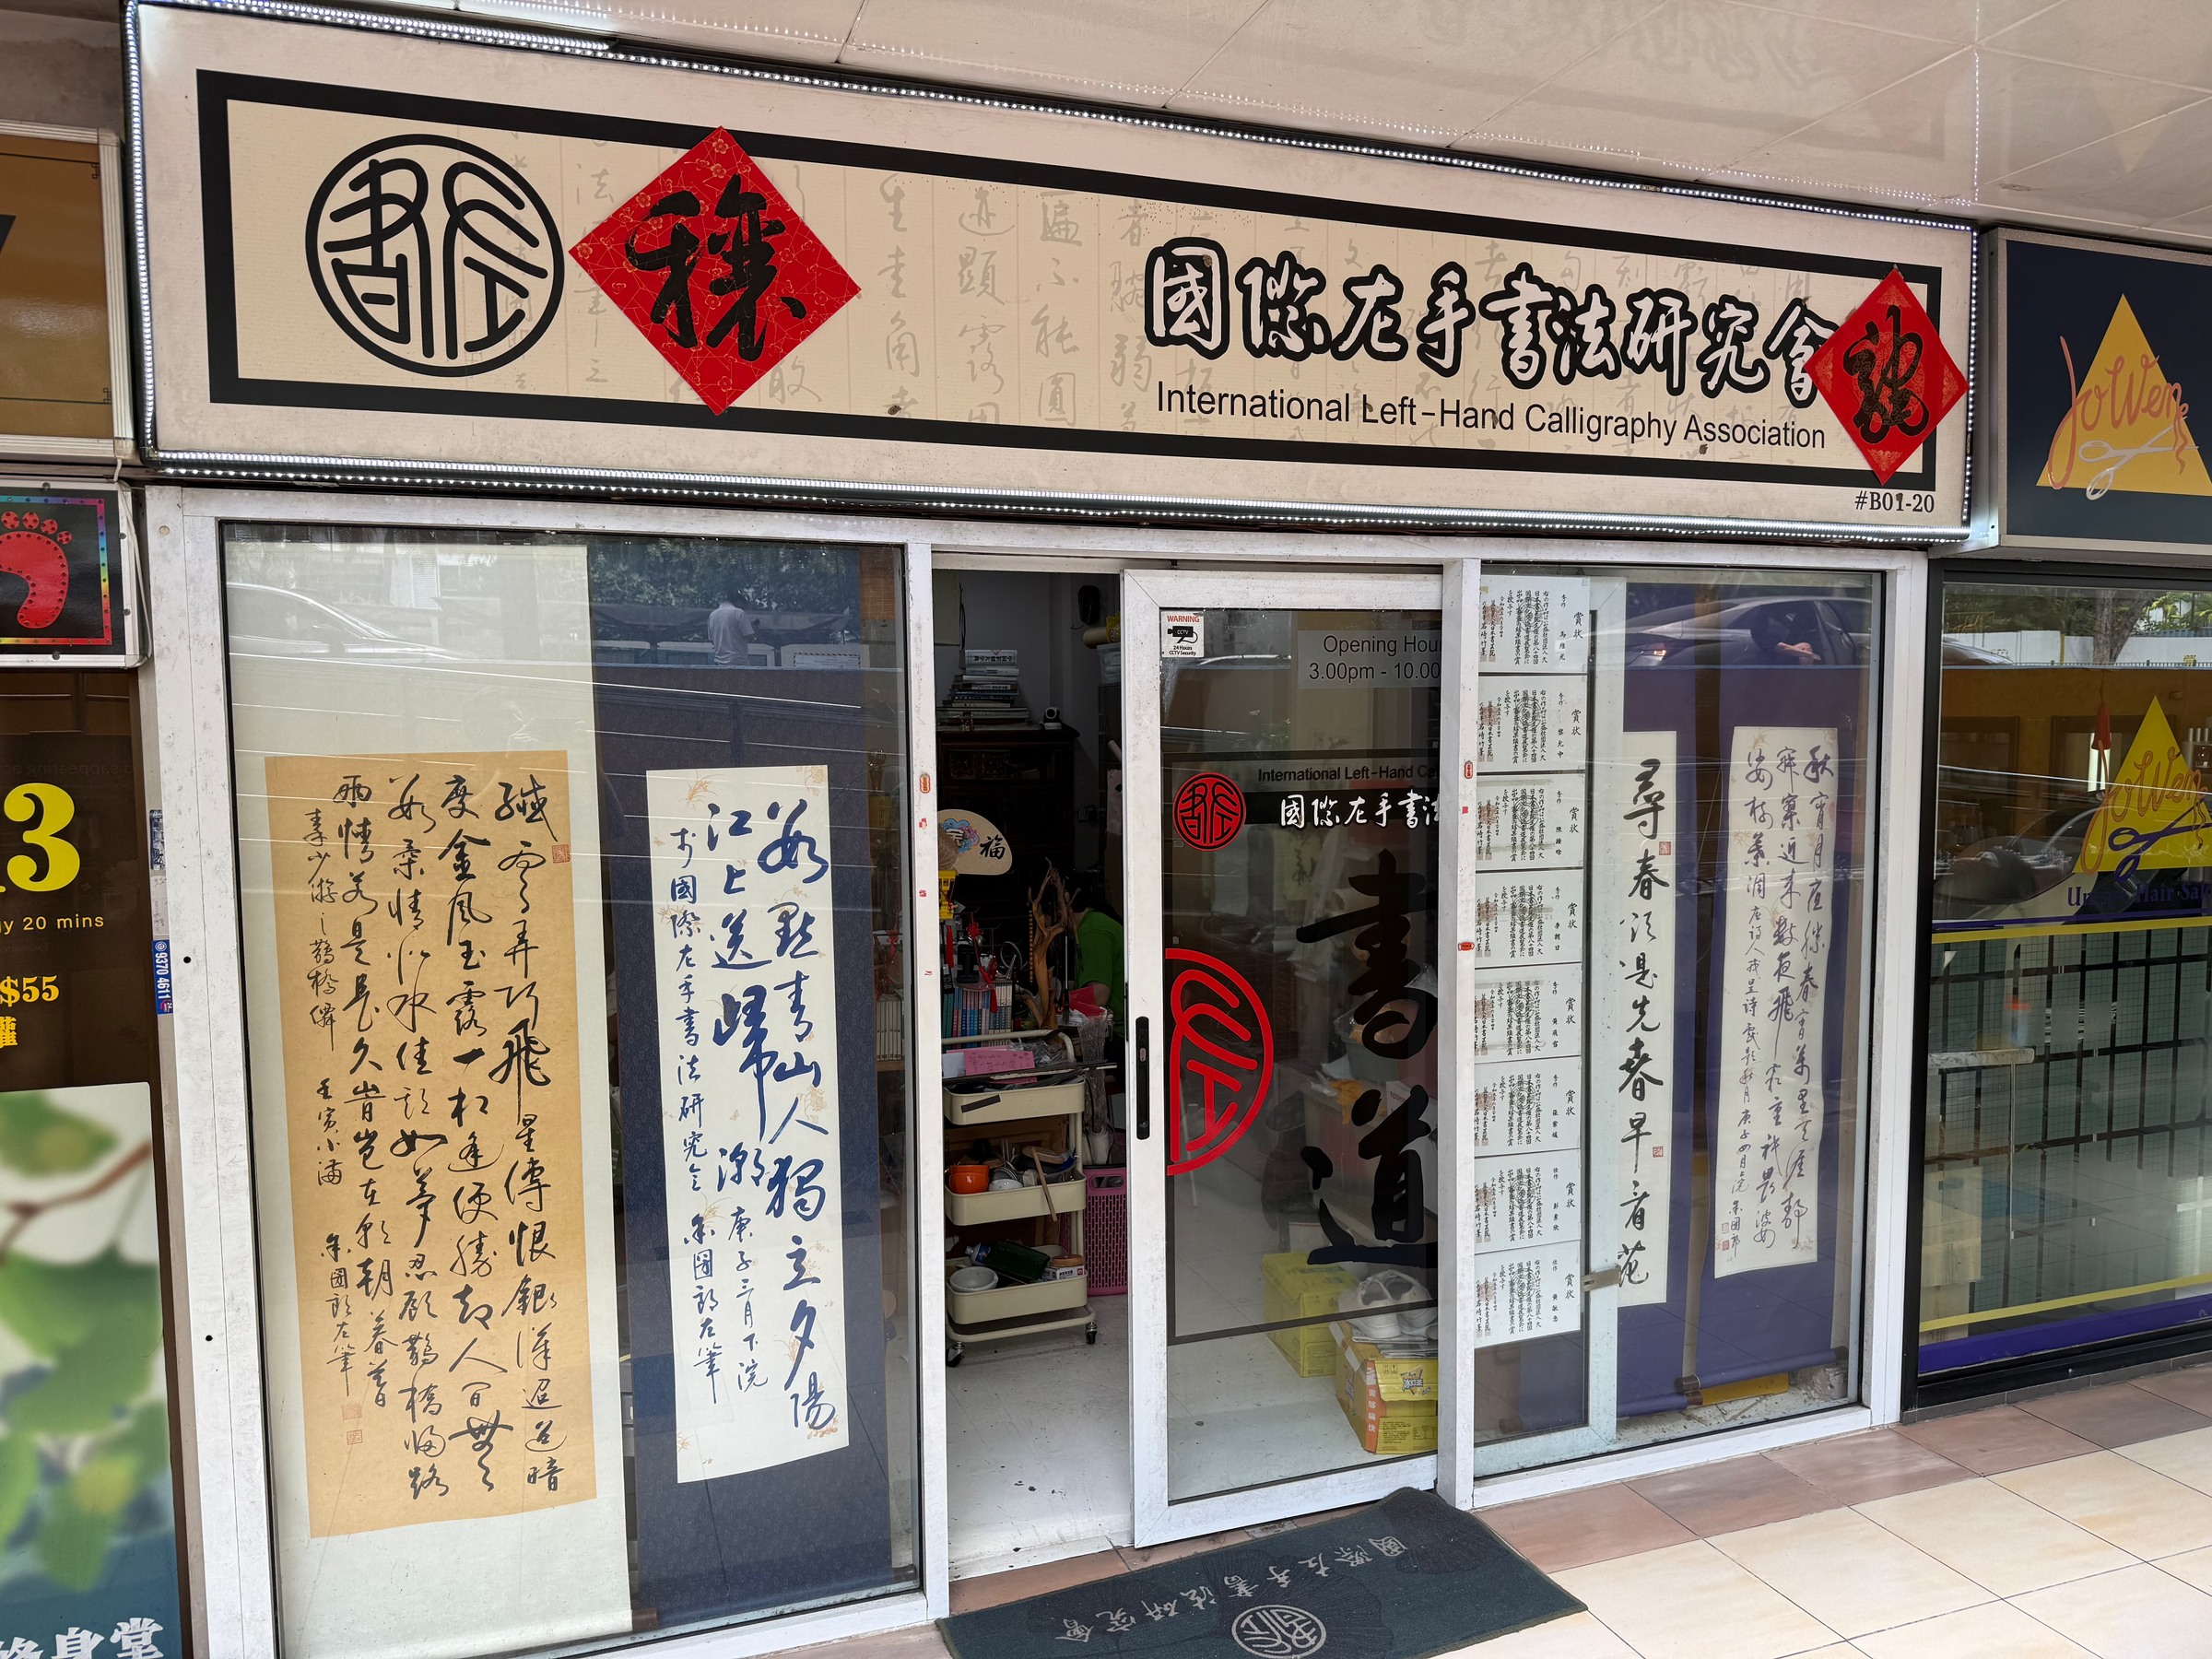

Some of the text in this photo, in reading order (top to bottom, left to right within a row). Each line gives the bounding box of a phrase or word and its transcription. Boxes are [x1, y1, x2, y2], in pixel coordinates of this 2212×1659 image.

[1158, 381, 1350, 422] International
[1525, 404, 1677, 446] Calligraphy
[1684, 415, 1826, 449] Association
[1854, 490, 1935, 513] #B01-20
[1324, 635, 1441, 656] Opening Hou
[1309, 663, 1374, 683] 3.00pm
[1258, 768, 1341, 782] International
[980, 836, 1006, 860] 福
[23, 916, 47, 931] 20
[57, 913, 104, 929] mins
[155, 950, 171, 1001] 9370 4611
[0, 975, 59, 1007] $55
